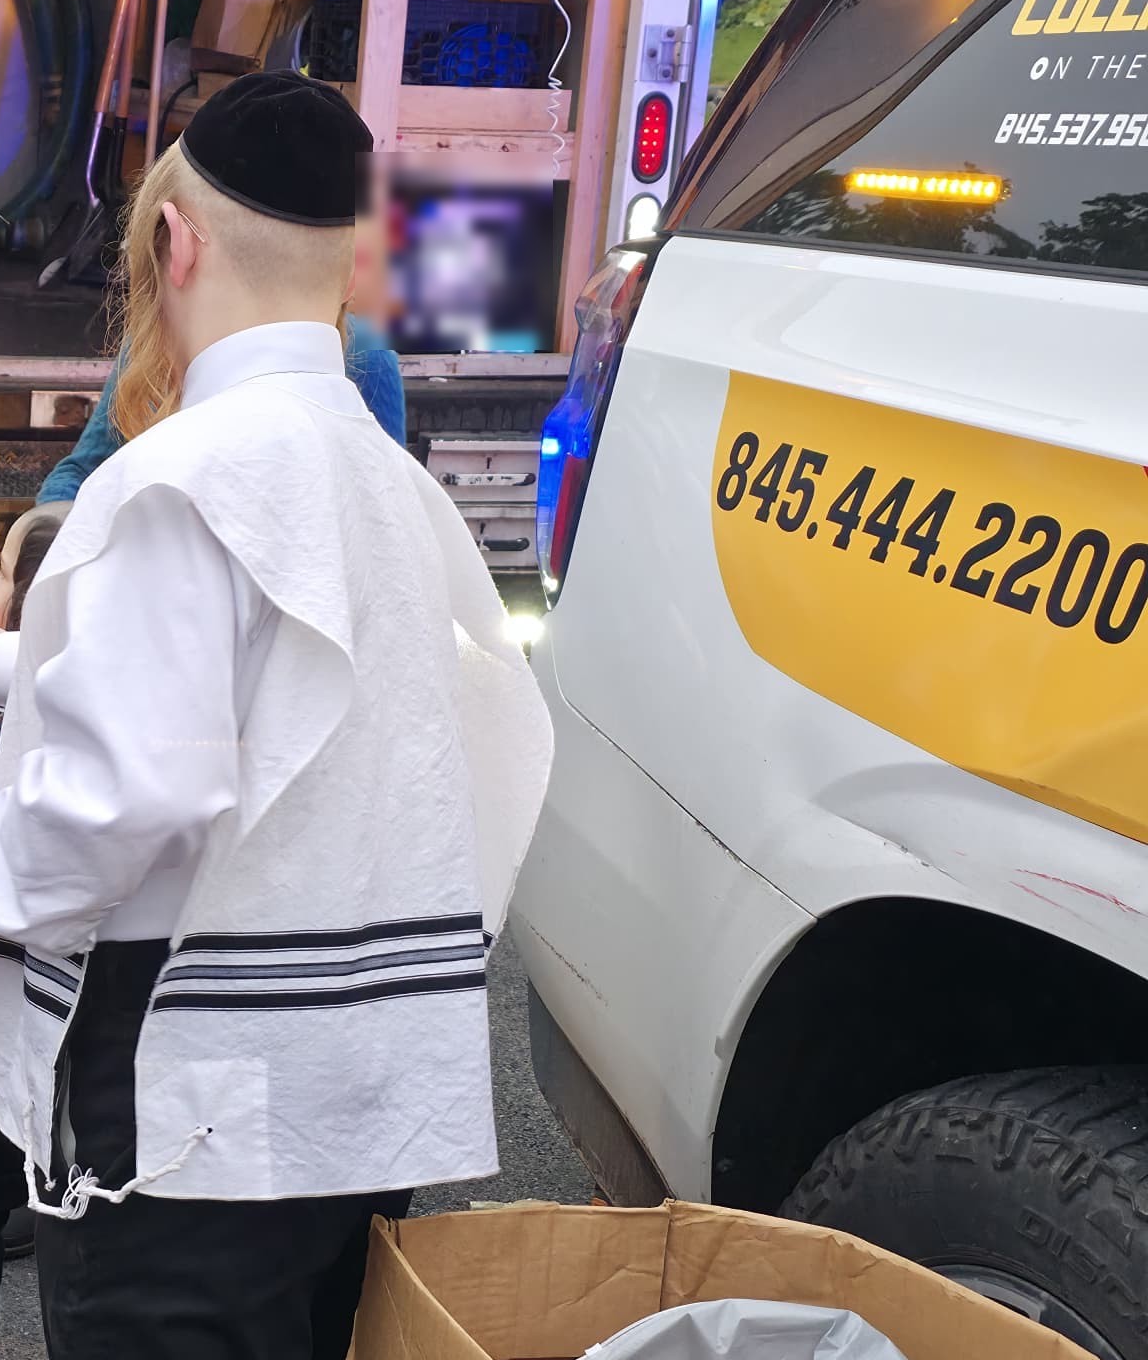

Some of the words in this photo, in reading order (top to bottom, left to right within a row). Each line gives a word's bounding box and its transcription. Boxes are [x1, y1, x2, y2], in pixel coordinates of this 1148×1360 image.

[1030, 56, 1073, 80] ON
[1087, 54, 1147, 79] THE
[716, 431, 1148, 645] 845.444.2200
